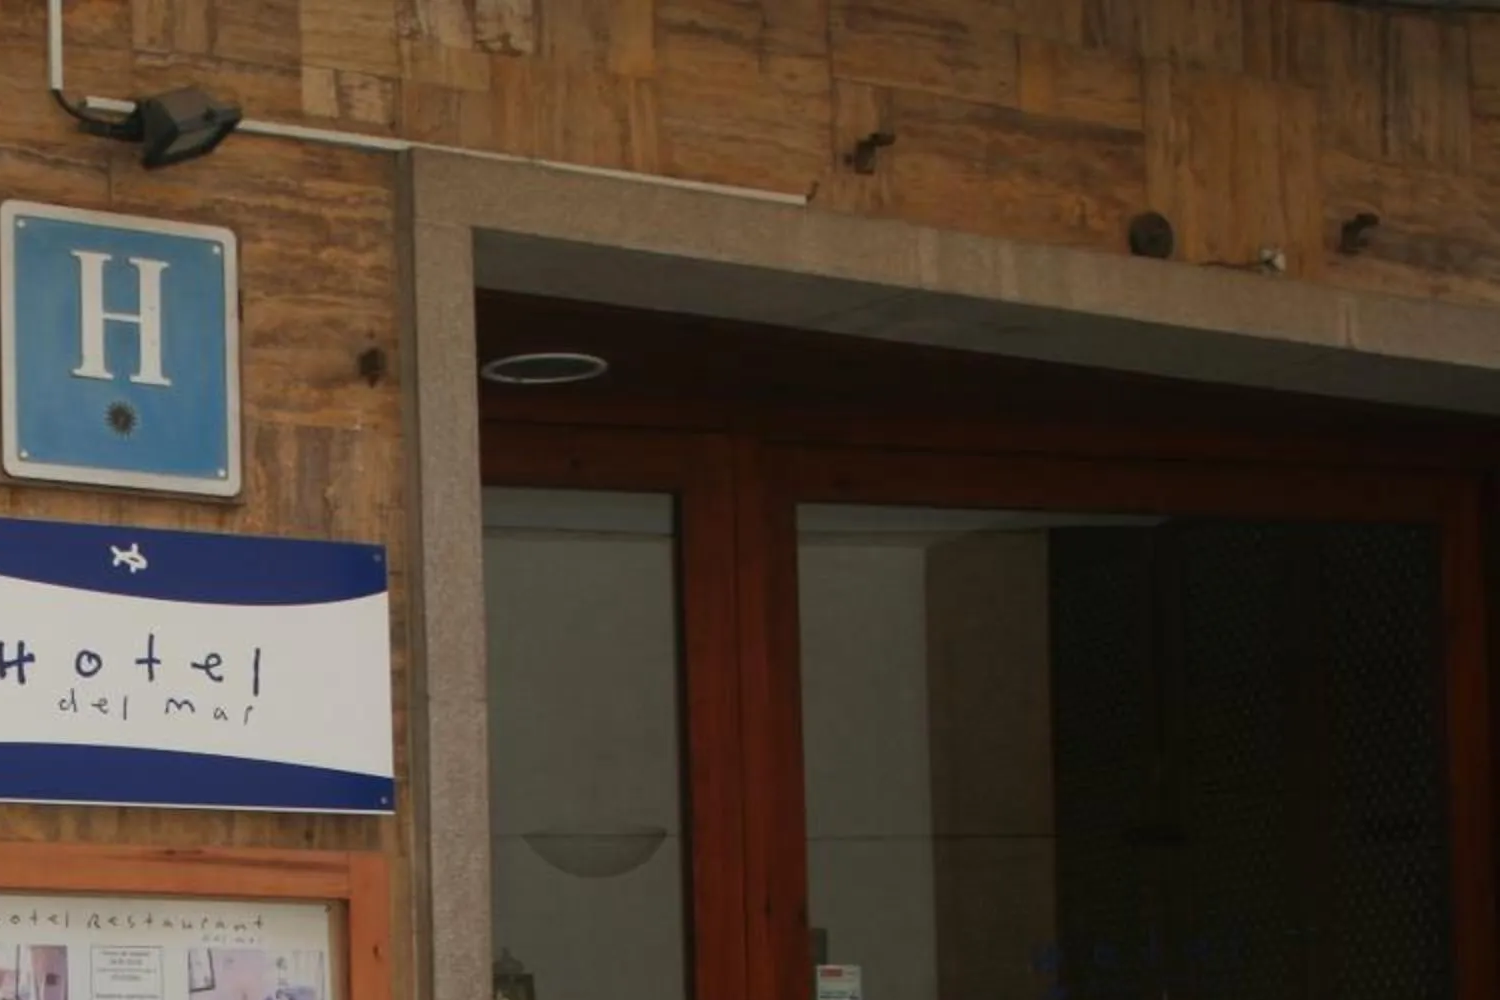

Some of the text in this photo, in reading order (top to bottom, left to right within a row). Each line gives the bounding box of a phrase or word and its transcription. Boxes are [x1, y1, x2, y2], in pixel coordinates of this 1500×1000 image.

[70, 249, 172, 387] H
[58, 687, 254, 726] del mar
